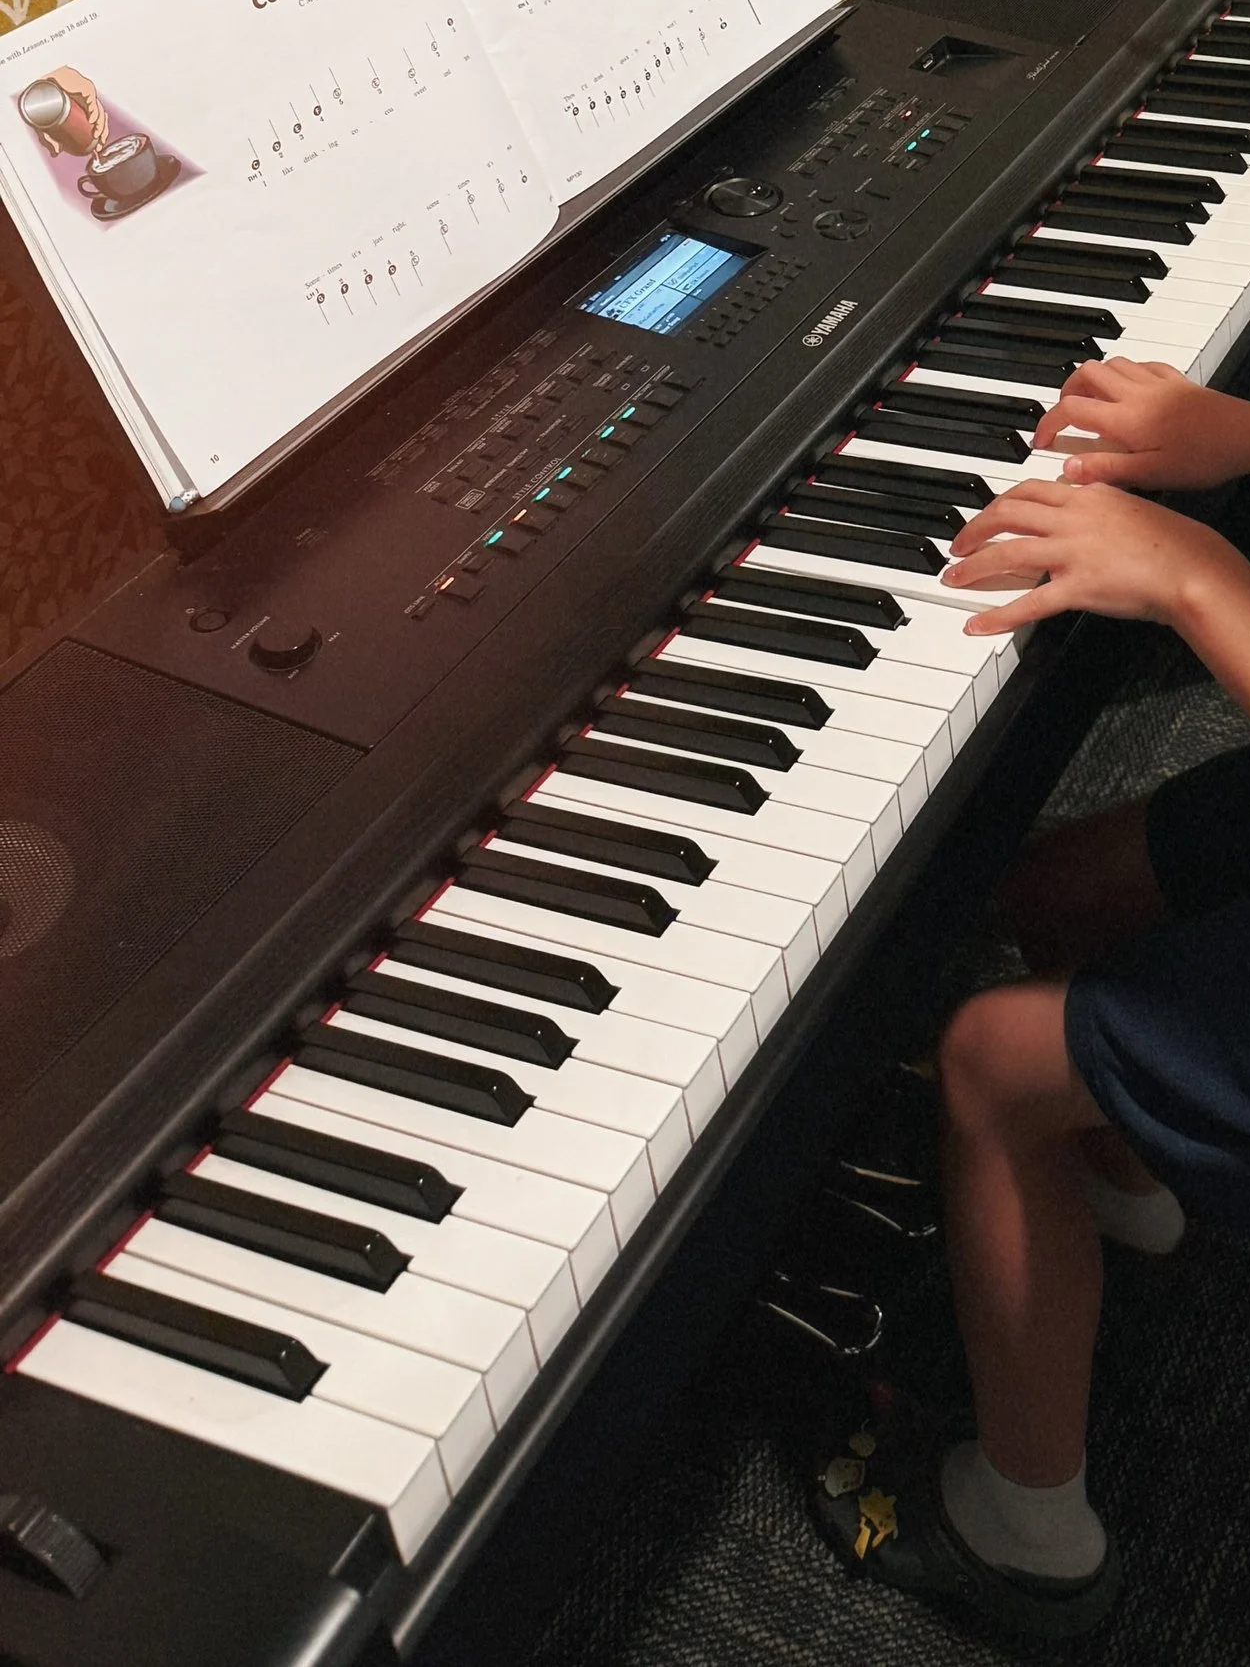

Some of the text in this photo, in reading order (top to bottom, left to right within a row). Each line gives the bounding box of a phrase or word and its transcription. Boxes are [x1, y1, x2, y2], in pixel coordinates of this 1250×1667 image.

[298, 0, 305, 7] C
[811, 300, 859, 336] YAMAHA
[210, 454, 220, 464] 10
[512, 483, 532, 500] STYLE
[530, 457, 562, 484] CONTROL
